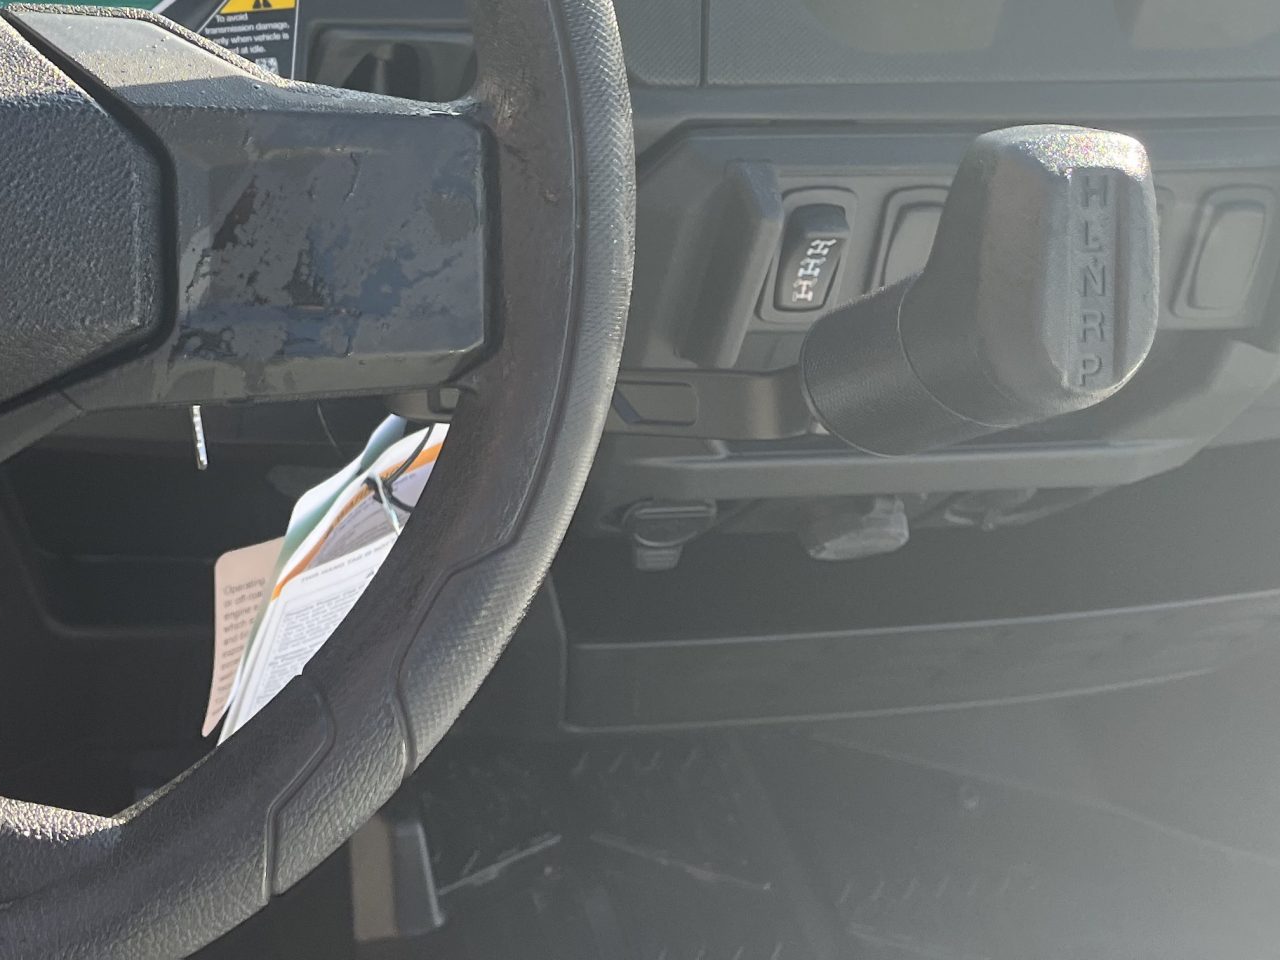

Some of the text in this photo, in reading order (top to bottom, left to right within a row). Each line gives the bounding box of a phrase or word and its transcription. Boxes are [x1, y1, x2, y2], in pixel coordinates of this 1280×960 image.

[205, 23, 255, 35] transmission
[215, 12, 248, 23] To avoid
[230, 35, 252, 44] when
[253, 32, 281, 42] vehicle
[281, 32, 290, 41] is
[1081, 174, 1109, 209] H
[1081, 264, 1107, 298] N
[1081, 310, 1105, 343] R
[1079, 352, 1103, 388] P
